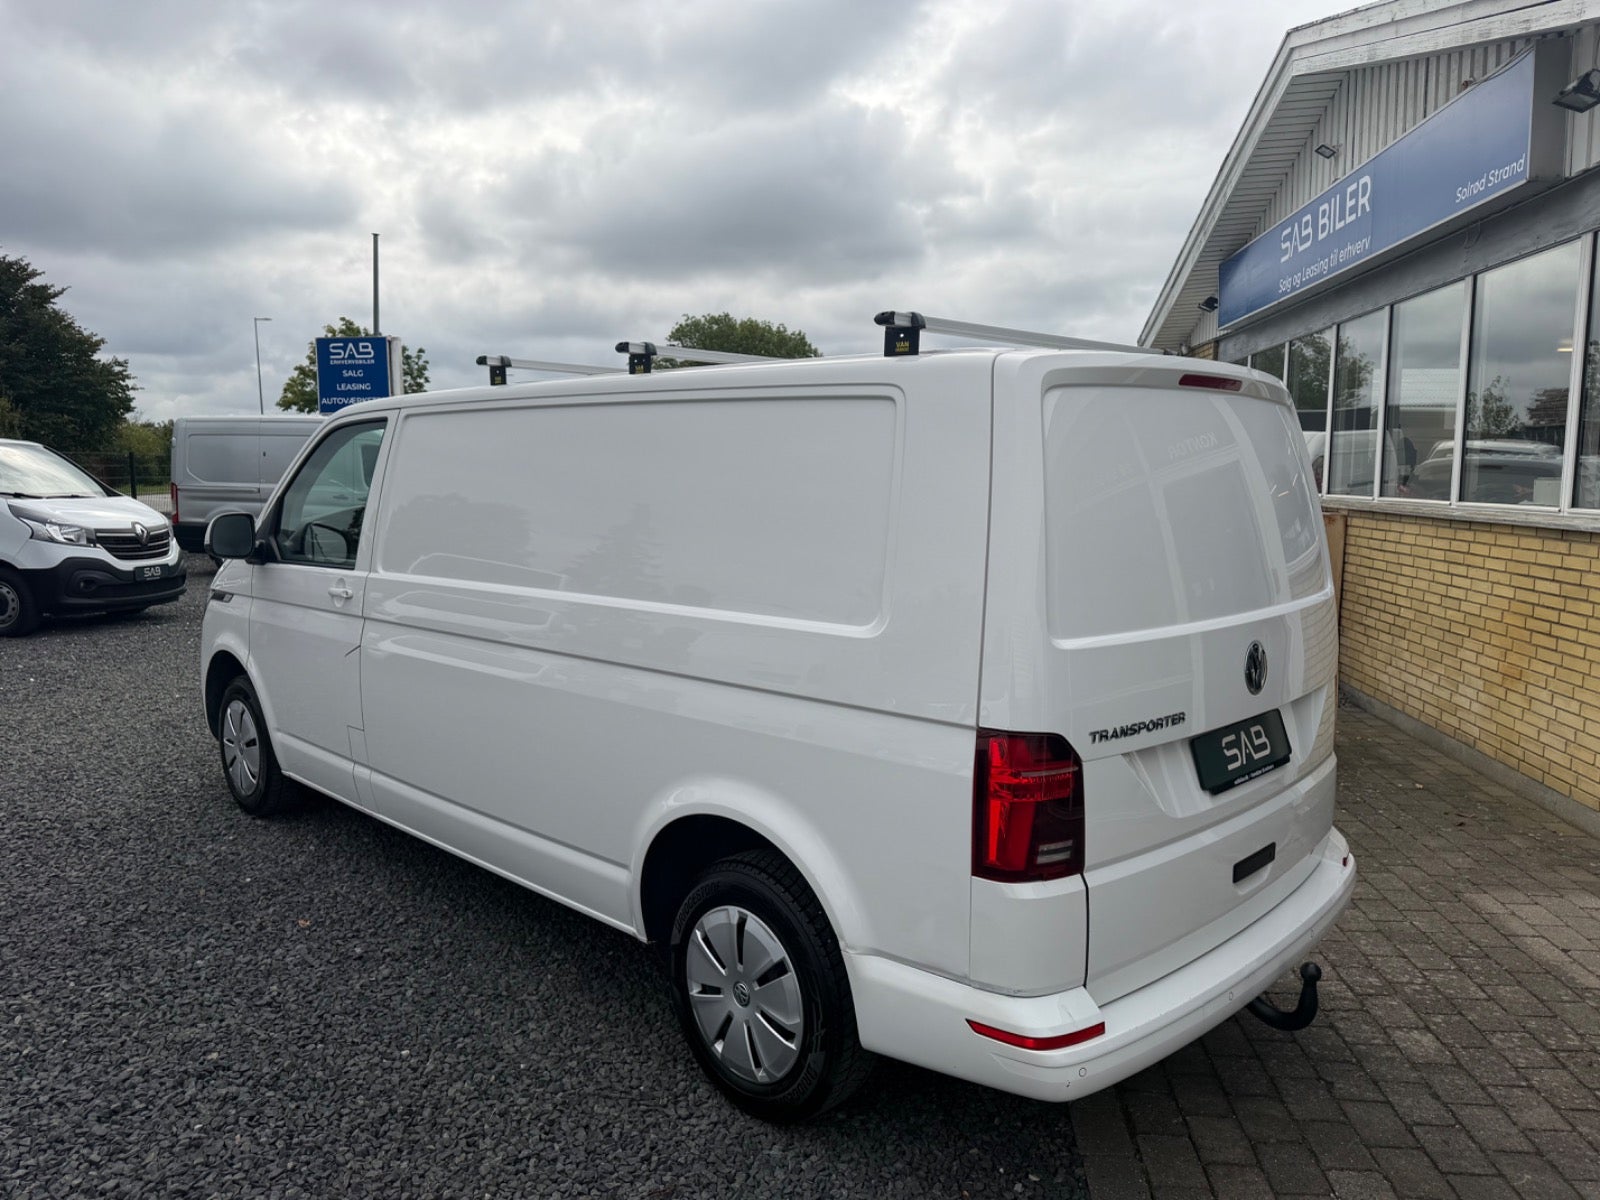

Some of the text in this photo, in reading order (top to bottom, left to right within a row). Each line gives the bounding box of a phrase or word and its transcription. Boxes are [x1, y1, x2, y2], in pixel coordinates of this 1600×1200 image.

[1487, 153, 1526, 187] Strand
[1280, 175, 1371, 264] SAB BILER
[1278, 235, 1372, 293] Salg og Leasing til erhverv
[329, 342, 375, 359] SAB
[336, 383, 372, 391] LEASING
[342, 369, 364, 377] SALG
[1088, 711, 1187, 744] TRANSPORTER
[1222, 725, 1271, 771] SAB
